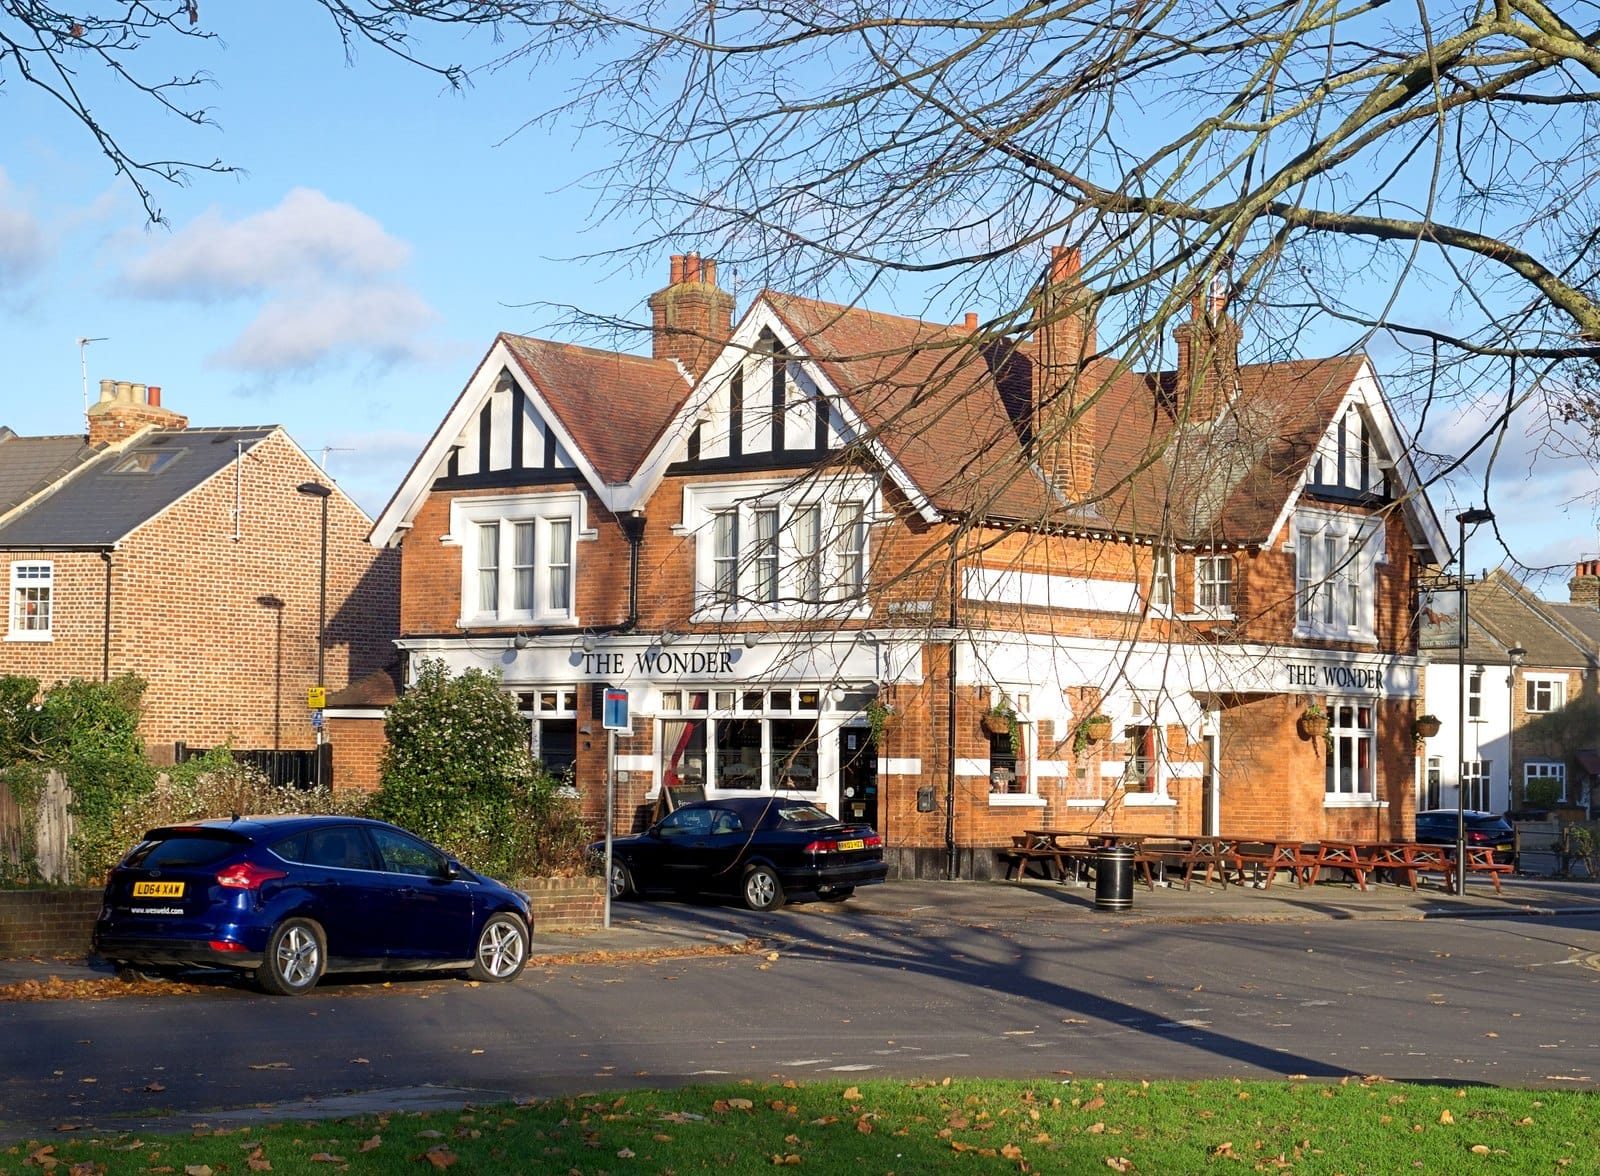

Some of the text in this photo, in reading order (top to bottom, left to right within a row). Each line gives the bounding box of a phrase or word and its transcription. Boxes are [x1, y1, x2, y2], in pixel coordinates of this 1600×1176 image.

[582, 652, 734, 674] THE WONDER
[1287, 664, 1384, 689] THE WONDER
[137, 883, 181, 895] LD64 XAW
